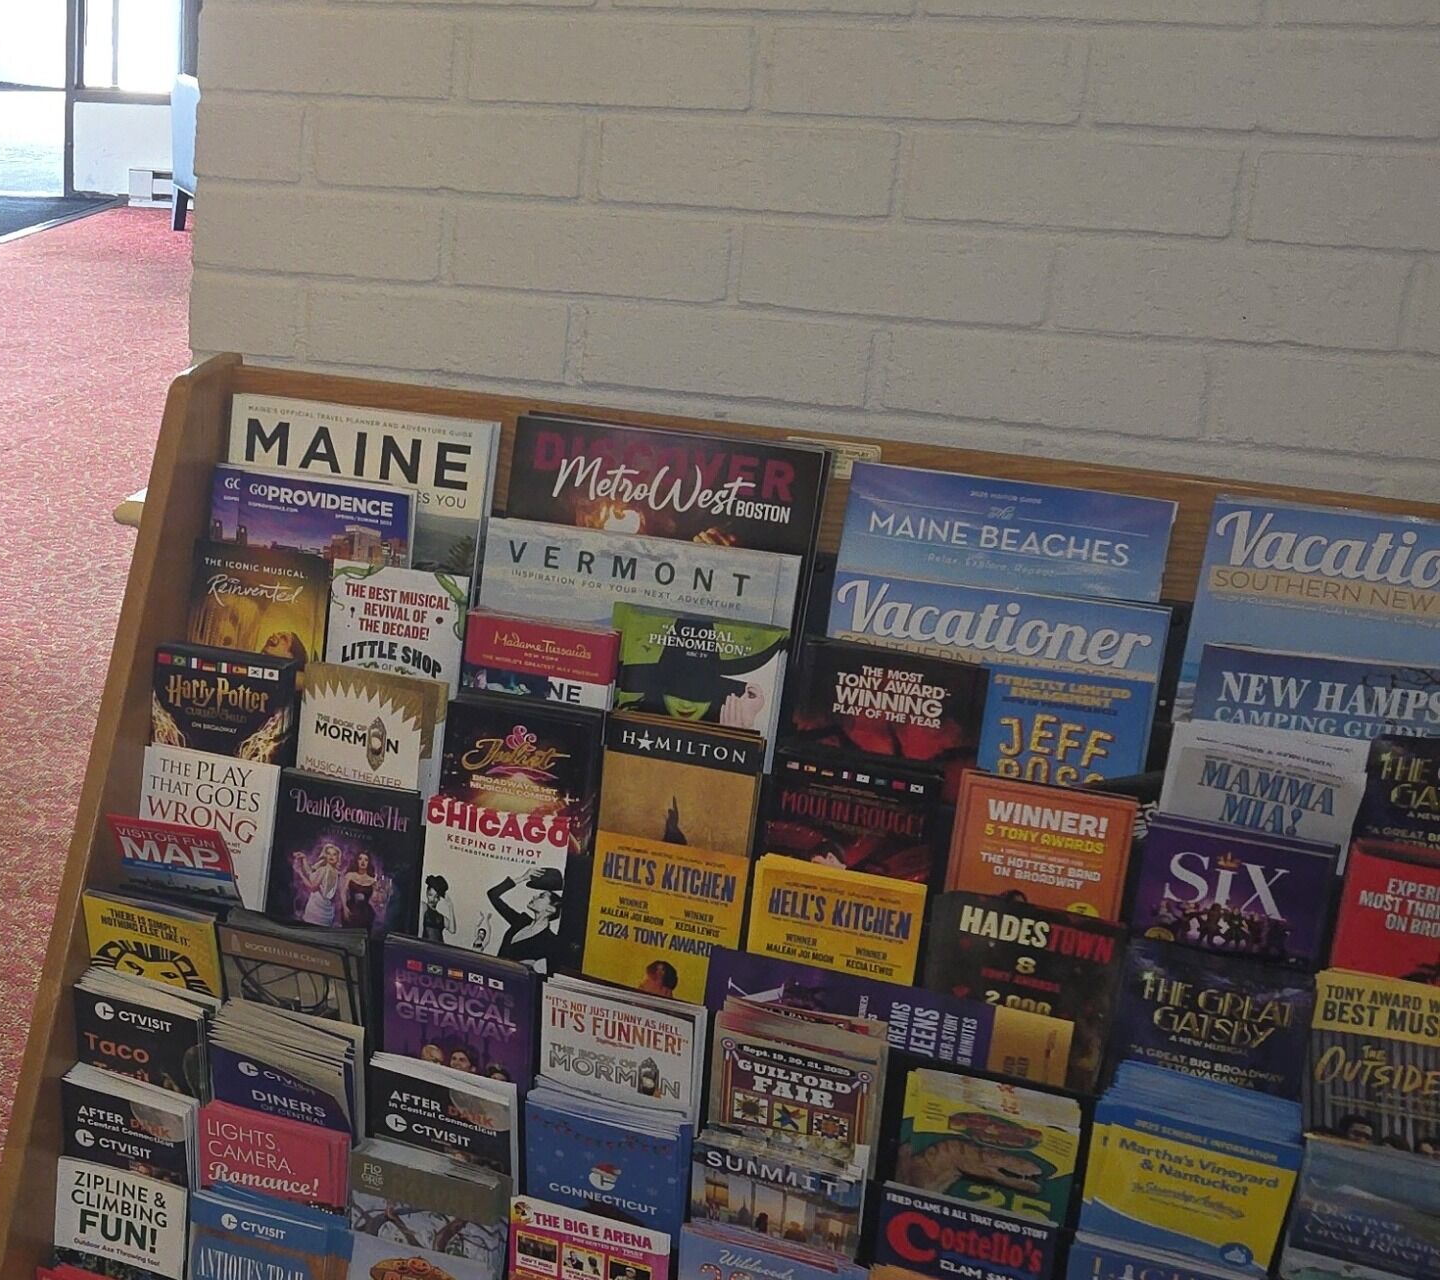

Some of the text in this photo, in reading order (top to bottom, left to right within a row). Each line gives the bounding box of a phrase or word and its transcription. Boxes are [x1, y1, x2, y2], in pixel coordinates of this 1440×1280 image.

[245, 418, 471, 490] MAINE
[249, 483, 393, 518] GOPROVIDENCE
[436, 494, 467, 510] YOU
[552, 456, 791, 523] MetroWest BOSTON
[868, 511, 1130, 568] MAINE BEACHES
[509, 540, 751, 597] VERMONT
[345, 582, 450, 611] THE BEST MUSICAL
[512, 570, 741, 610] INSPIRATION FOR YOUR NEXT ADVENTURE
[1214, 570, 1360, 603] SOUTHERN
[1370, 587, 1435, 612] NEW
[358, 618, 430, 641] THE DECADE!
[364, 601, 428, 624] REVIVAL OF
[836, 579, 1153, 669] Vacationer
[342, 640, 442, 678] LITTLE SHOP
[494, 631, 592, 659] Madame Tussauds
[862, 665, 924, 683] THE MOST
[165, 674, 269, 713] Harry Potter
[834, 685, 943, 719] WINNING
[832, 703, 941, 729] PLAY OF THE YEAR
[622, 729, 747, 764] HAMILTON
[999, 713, 1115, 769] JEFF
[160, 759, 253, 788] THE PLAY
[1199, 759, 1336, 816] MAMMA
[149, 774, 261, 813] THAT GOES
[289, 788, 330, 815] Death
[386, 811, 410, 833] Her
[147, 795, 258, 845] WRONG
[426, 794, 570, 848] CHICAGO
[988, 798, 1109, 839] WINNER!
[116, 827, 216, 849] VISITOR FUN
[120, 836, 220, 871] MAP
[447, 834, 542, 859] KEEPING IT HOT
[984, 824, 1104, 854] 5 TONY AWARDS
[602, 852, 657, 885] HELL'S
[662, 863, 736, 903] KITCHEN
[980, 851, 1005, 864] THE
[1007, 858, 1065, 875] HOTTEST
[1068, 867, 1101, 882] BAND
[993, 866, 1084, 890] ON BROADWAY
[1163, 851, 1290, 922] SIX
[768, 887, 827, 923] HELL'S
[832, 897, 912, 940] KITCHEN
[959, 905, 1115, 964] HADESTOWN
[1015, 956, 1037, 974] 8
[395, 981, 517, 1033] MAGICAL
[1326, 985, 1422, 1011] TONY AWARD
[118, 1009, 172, 1033] CTVISIT
[1153, 1006, 1276, 1048] GATSBY
[83, 1031, 150, 1064] Taco
[737, 1057, 852, 1095] GUILFORD
[752, 1074, 834, 1109] FAIR
[251, 1089, 327, 1118] DINERS
[98, 1136, 152, 1160] CTVISIT
[207, 1118, 281, 1152] LIGHTS.
[412, 1122, 471, 1148] CTVISIT
[208, 1140, 297, 1176] CAMERA.
[705, 1150, 841, 1197] SUMMIT
[1119, 1137, 1279, 1188] Martha's Vineyard
[72, 1170, 167, 1210] ZIPLINE &
[208, 1161, 320, 1197] Romance!
[1140, 1159, 1248, 1196] & Nantucket
[70, 1189, 168, 1229] CLIMBING
[548, 1182, 658, 1216] CONNECTICUT
[78, 1208, 158, 1254] FUN!
[240, 1219, 287, 1241] CTVISIT
[534, 1212, 652, 1250] THE BIG E ARENA
[886, 1211, 1043, 1274] Costello's
[939, 1259, 982, 1280] CLAM
